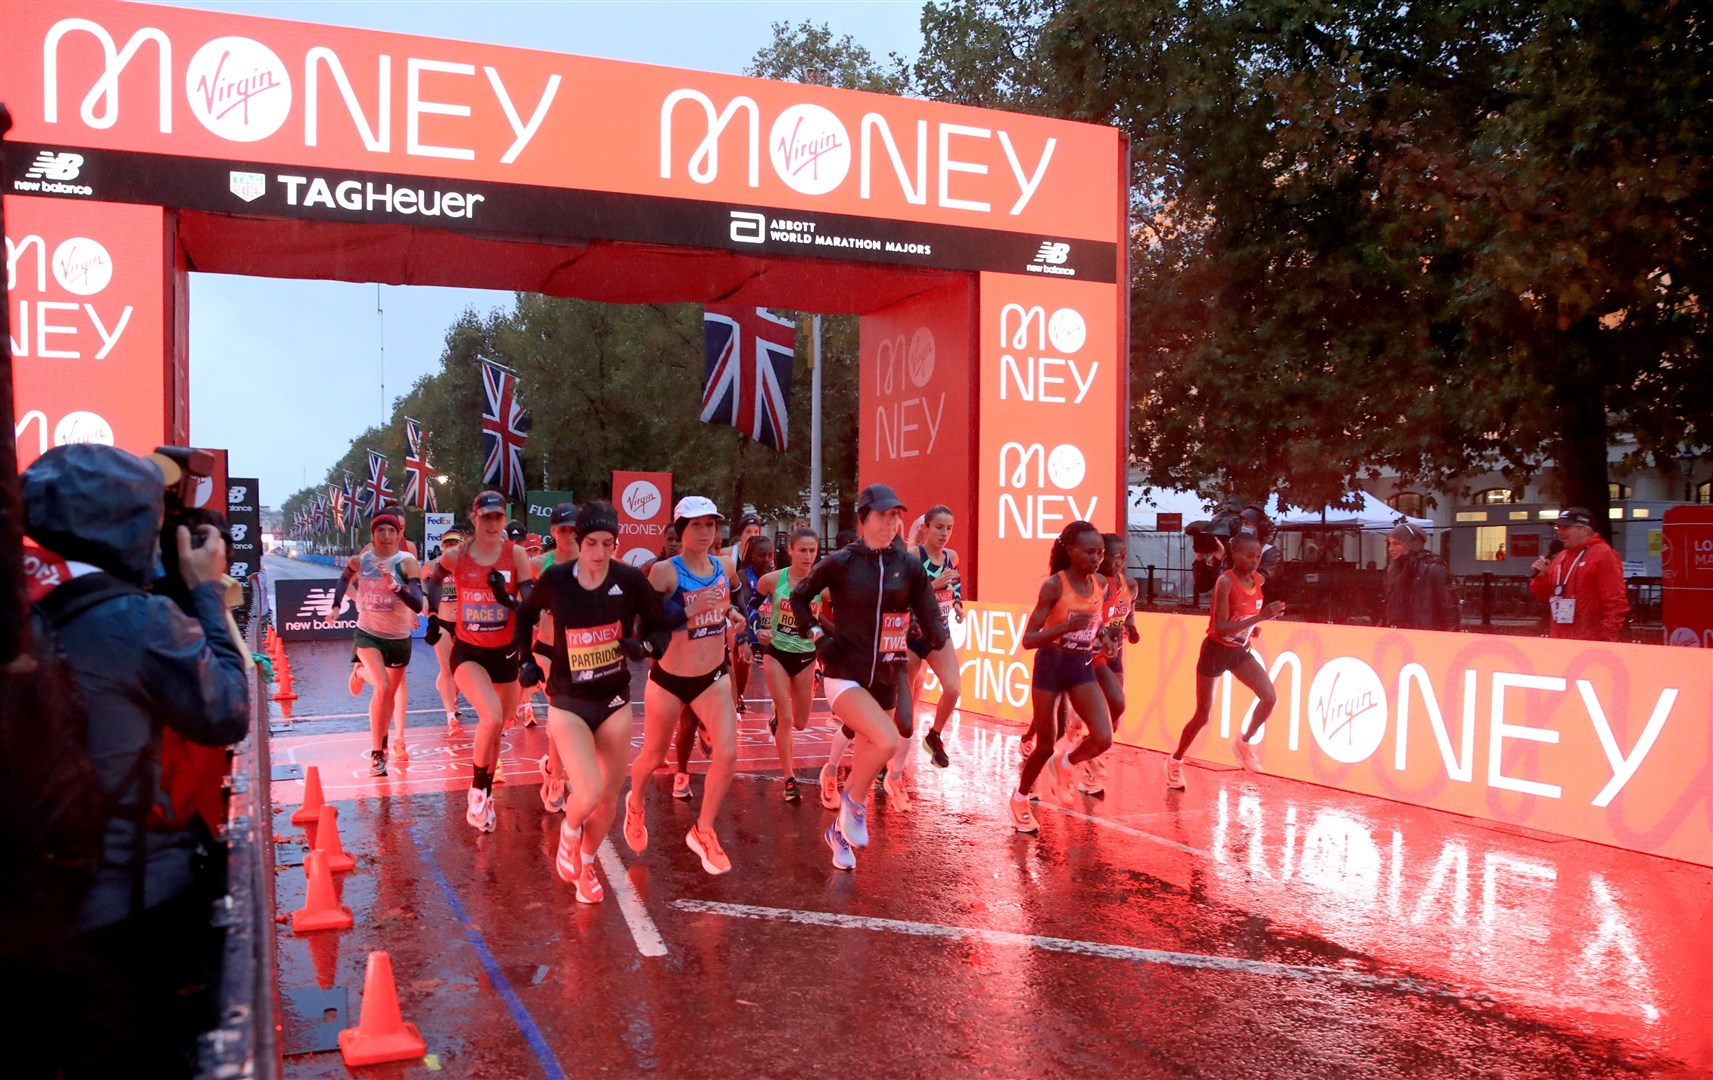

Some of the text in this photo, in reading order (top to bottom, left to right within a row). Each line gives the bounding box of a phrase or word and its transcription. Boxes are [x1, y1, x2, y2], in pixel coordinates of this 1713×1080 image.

[44, 18, 561, 163] MONEY
[197, 50, 280, 125] Virgin
[660, 88, 1057, 215] MONEY
[778, 115, 842, 180] Virgin
[14, 180, 93, 195] new balance
[770, 219, 816, 233] ABBOTT
[770, 231, 931, 255] WORLD MARATHON MAJORS
[1000, 354, 1099, 404] NEY
[875, 392, 946, 462] NEY
[529, 504, 553, 517] FLO
[627, 487, 656, 514] Virgin
[427, 516, 452, 525] FedEx
[427, 533, 443, 541] Fed
[463, 591, 497, 602] MONE
[285, 619, 358, 630] new baanc
[466, 608, 504, 621] PACE 5
[569, 626, 619, 644] MONEY
[571, 647, 618, 668] PARTRIDG
[1316, 671, 1378, 747] Virgin
